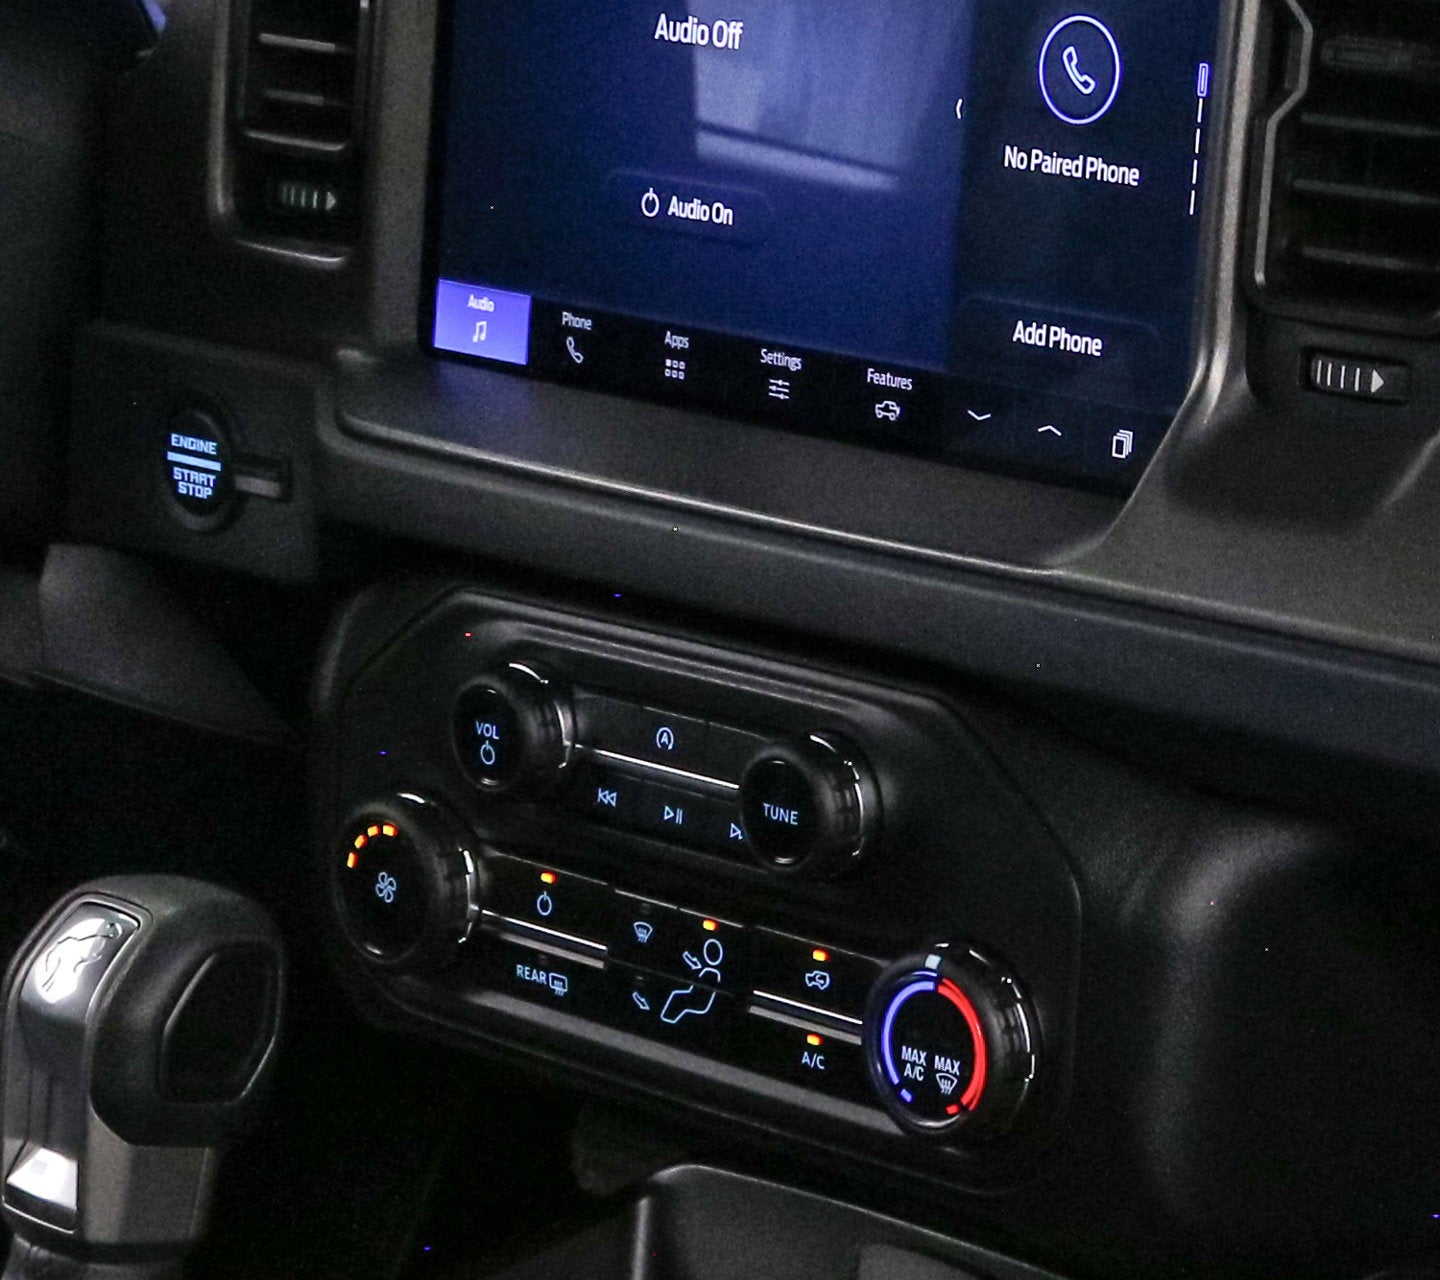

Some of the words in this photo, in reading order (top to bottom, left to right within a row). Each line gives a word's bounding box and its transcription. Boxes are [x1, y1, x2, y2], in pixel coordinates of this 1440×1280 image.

[654, 12, 710, 46] Audio
[712, 19, 744, 50] Off
[1003, 144, 1028, 170] No
[1030, 148, 1084, 178] Paired
[1085, 156, 1141, 187] Phone
[667, 195, 710, 222] Audio
[711, 202, 734, 226] On
[467, 293, 495, 313] Audio
[561, 310, 592, 332] Phone
[663, 330, 690, 351] Apps
[1012, 319, 1047, 348] Add
[1048, 325, 1103, 357] Phone
[760, 348, 802, 372] Settings
[866, 367, 913, 392] Features
[170, 433, 218, 456] ENGINE
[173, 466, 217, 488] START
[177, 481, 213, 500] STOP
[474, 720, 501, 741] VOL
[762, 801, 799, 827] TUNE
[515, 963, 548, 985] REAR
[801, 1051, 826, 1071] A/C
[901, 1045, 928, 1067] MAX
[934, 1054, 961, 1076] MAX
[903, 1062, 924, 1081] A/C
